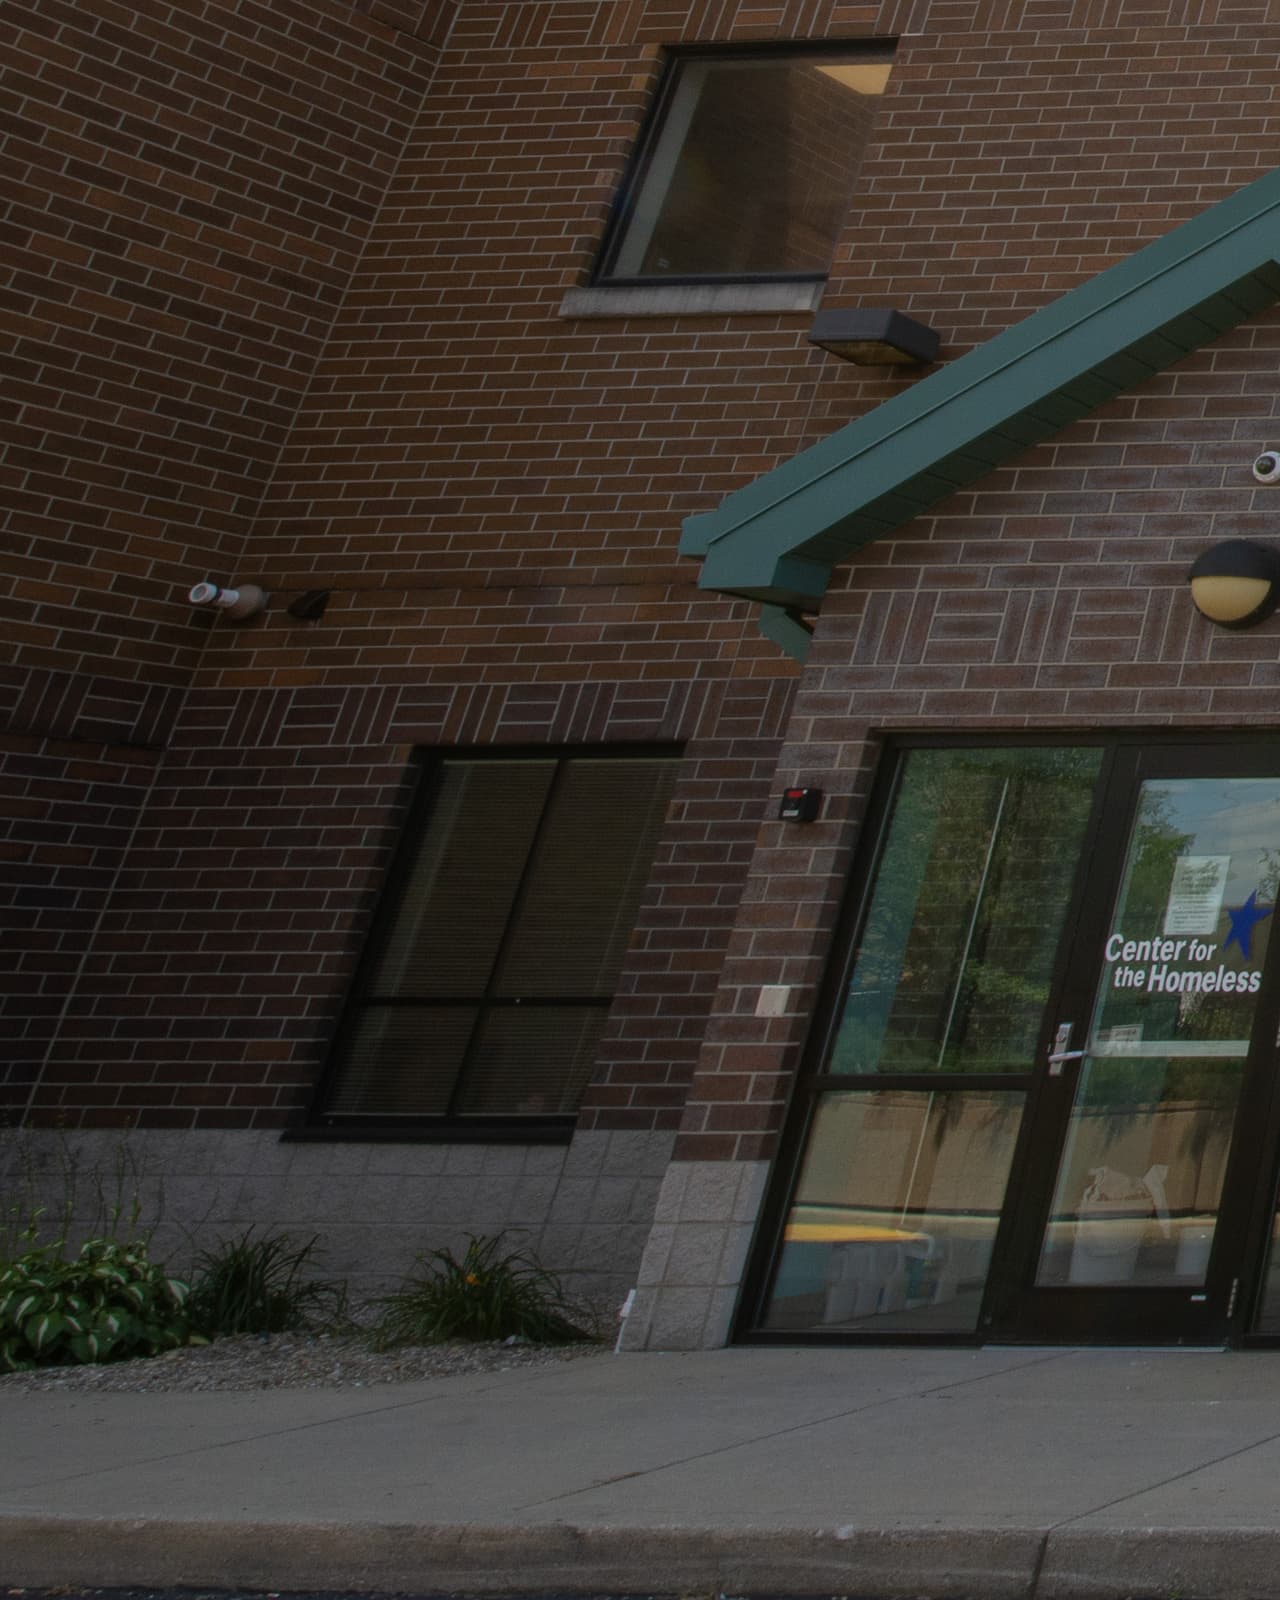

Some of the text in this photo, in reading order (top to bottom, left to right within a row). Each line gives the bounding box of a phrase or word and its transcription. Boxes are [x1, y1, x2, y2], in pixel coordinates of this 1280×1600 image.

[1105, 933, 1217, 962] Center for
[1114, 964, 1262, 993] the Homeless
